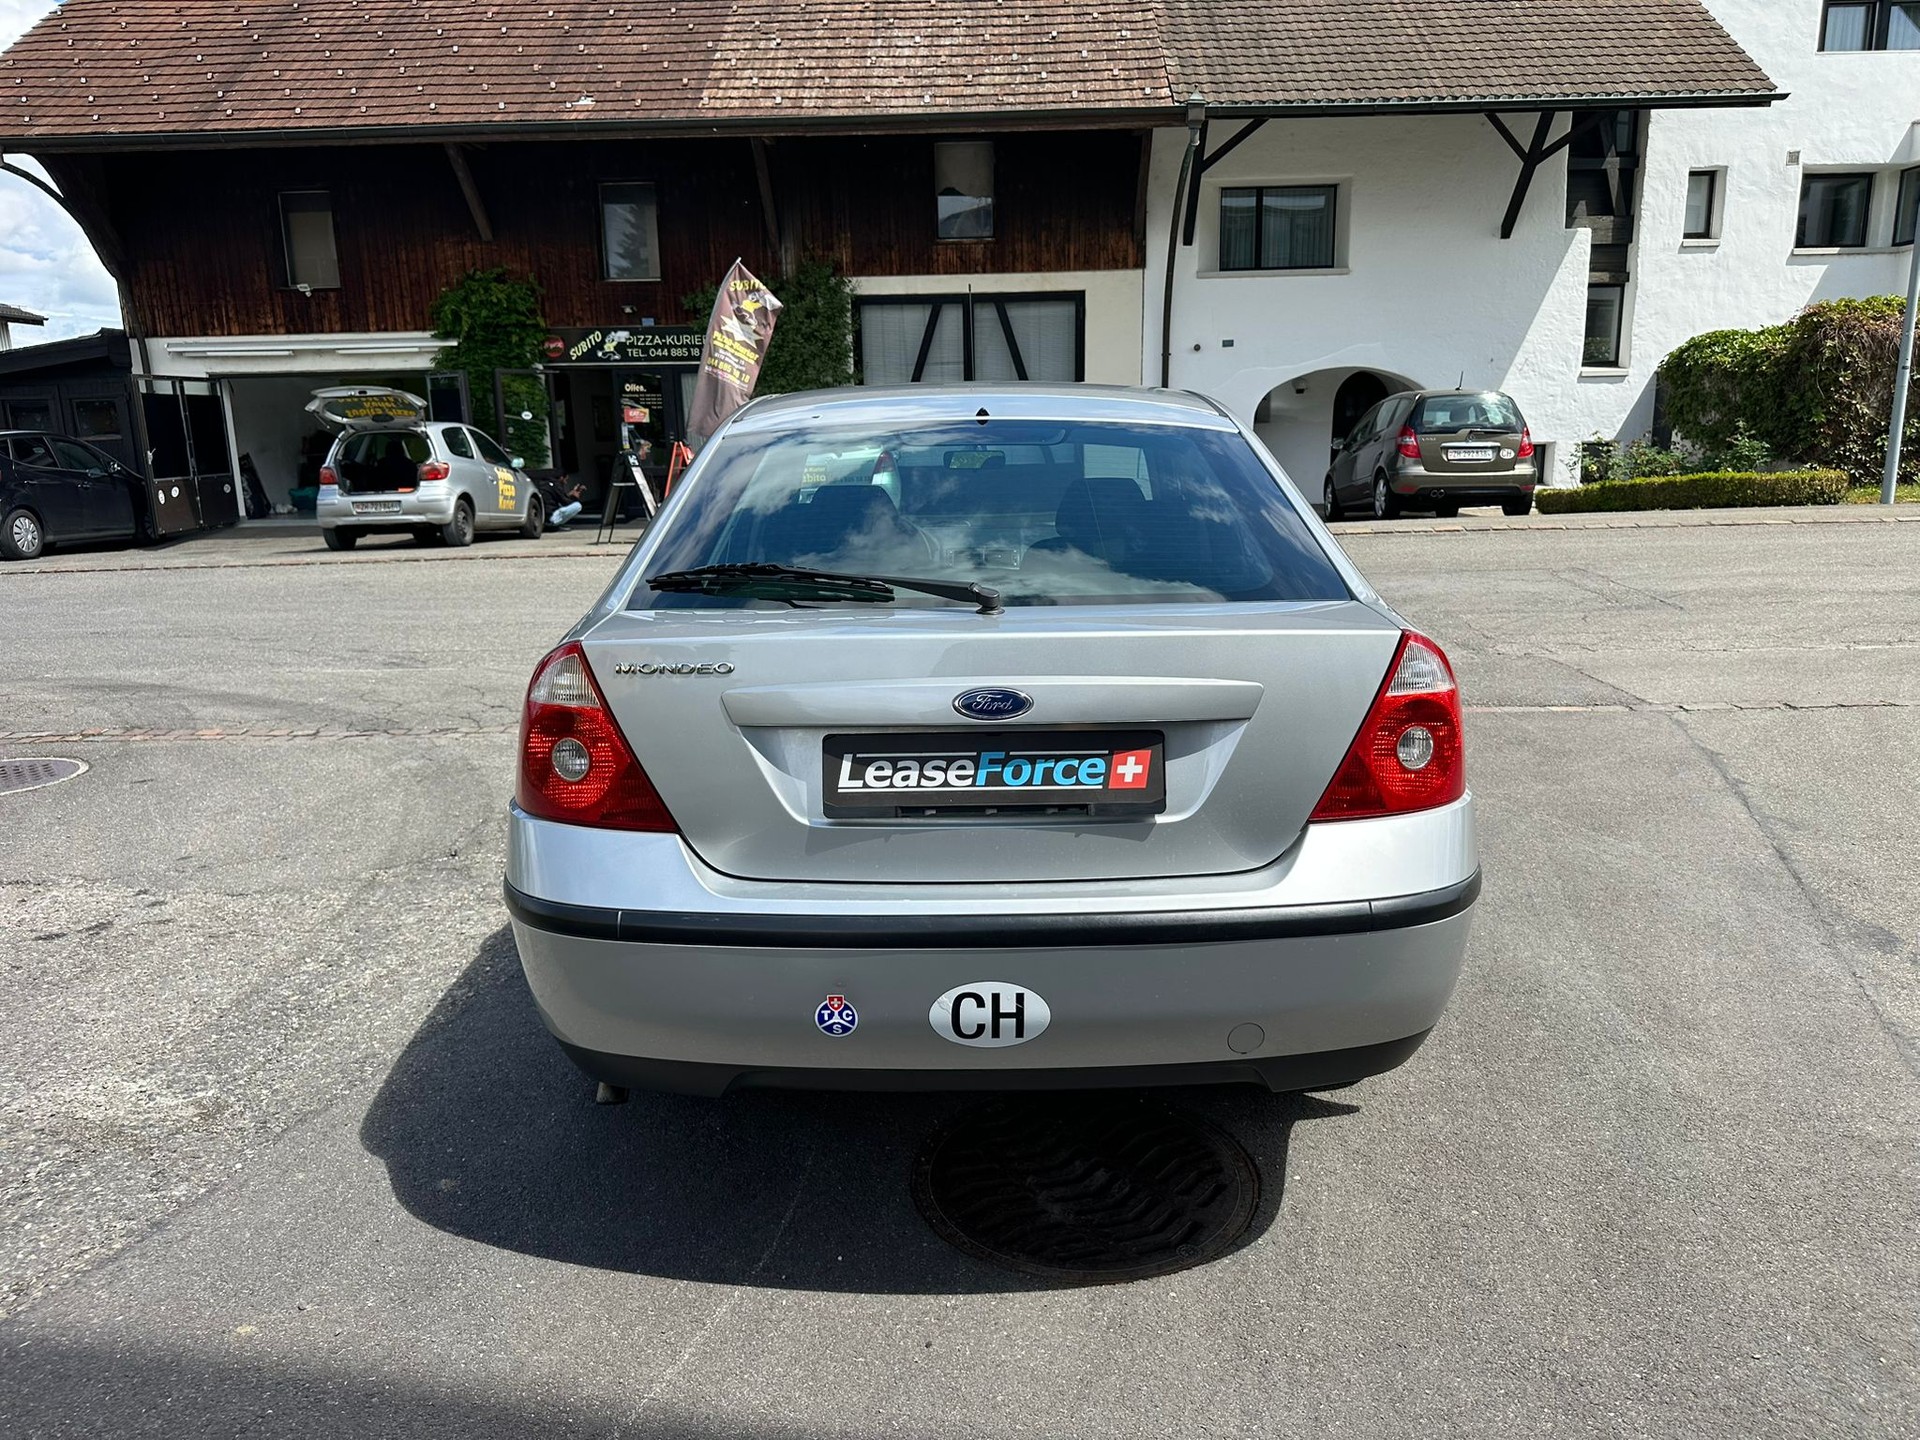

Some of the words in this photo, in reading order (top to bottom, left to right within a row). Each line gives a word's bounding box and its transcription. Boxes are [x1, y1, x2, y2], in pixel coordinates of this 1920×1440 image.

[569, 330, 602, 361] SUBITO
[627, 349, 647, 358] TEL.
[650, 348, 668, 357] 044
[671, 348, 688, 357] 885
[690, 348, 700, 357] 18
[1501, 449, 1513, 458] CH
[614, 661, 736, 676] MONDEO
[971, 693, 1014, 711] Ford
[837, 751, 1107, 788] LeaseForce
[951, 991, 1025, 1040] CH
